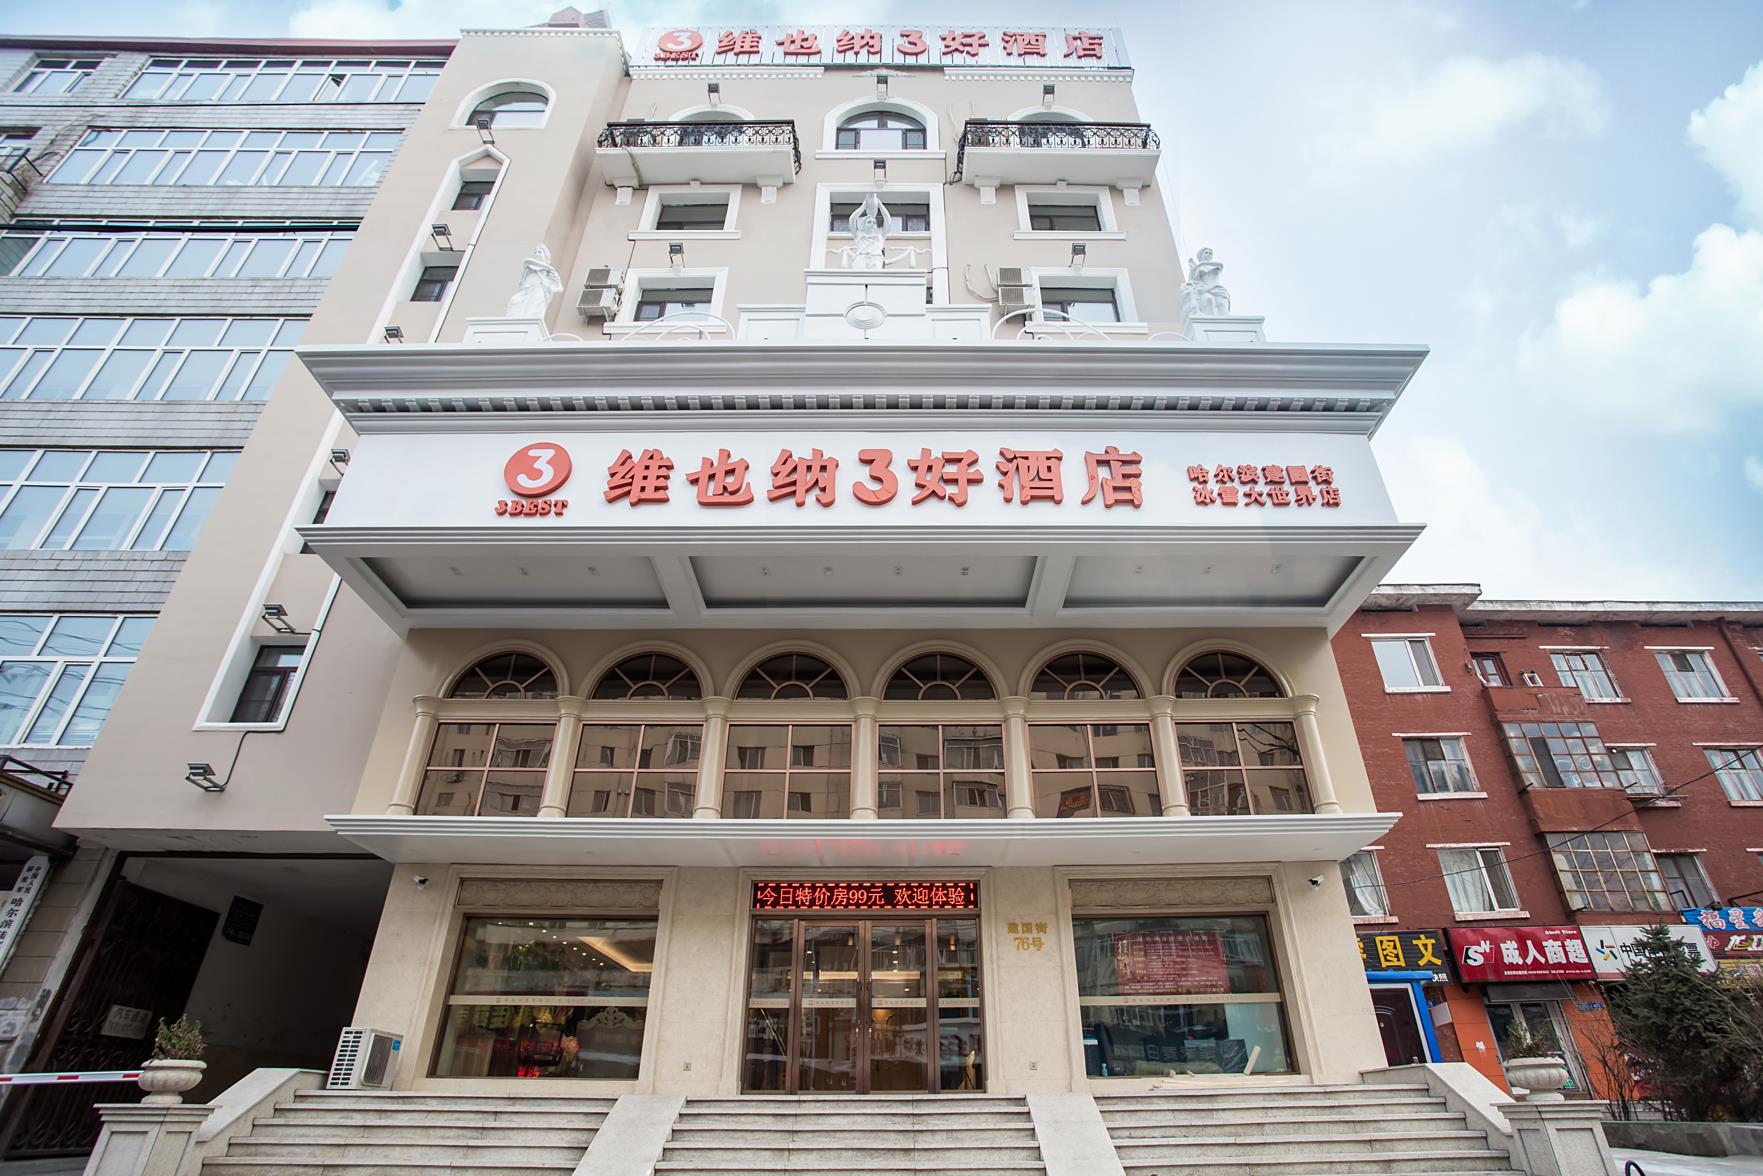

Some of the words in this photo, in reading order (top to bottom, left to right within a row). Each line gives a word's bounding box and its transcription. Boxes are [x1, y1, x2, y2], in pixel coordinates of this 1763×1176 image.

[715, 28, 1103, 60] 维也纳3好酒店
[516, 448, 555, 488] 3
[603, 445, 1144, 509] 维也纳3好酒店
[494, 499, 568, 516] 3BEST
[1192, 485, 1342, 507] 冰雪大世界店
[761, 887, 884, 906] 今日特价房99元
[893, 887, 966, 906] 欢迎体验
[1013, 936, 1045, 951] 76号
[1500, 939, 1589, 965] 成人商超
